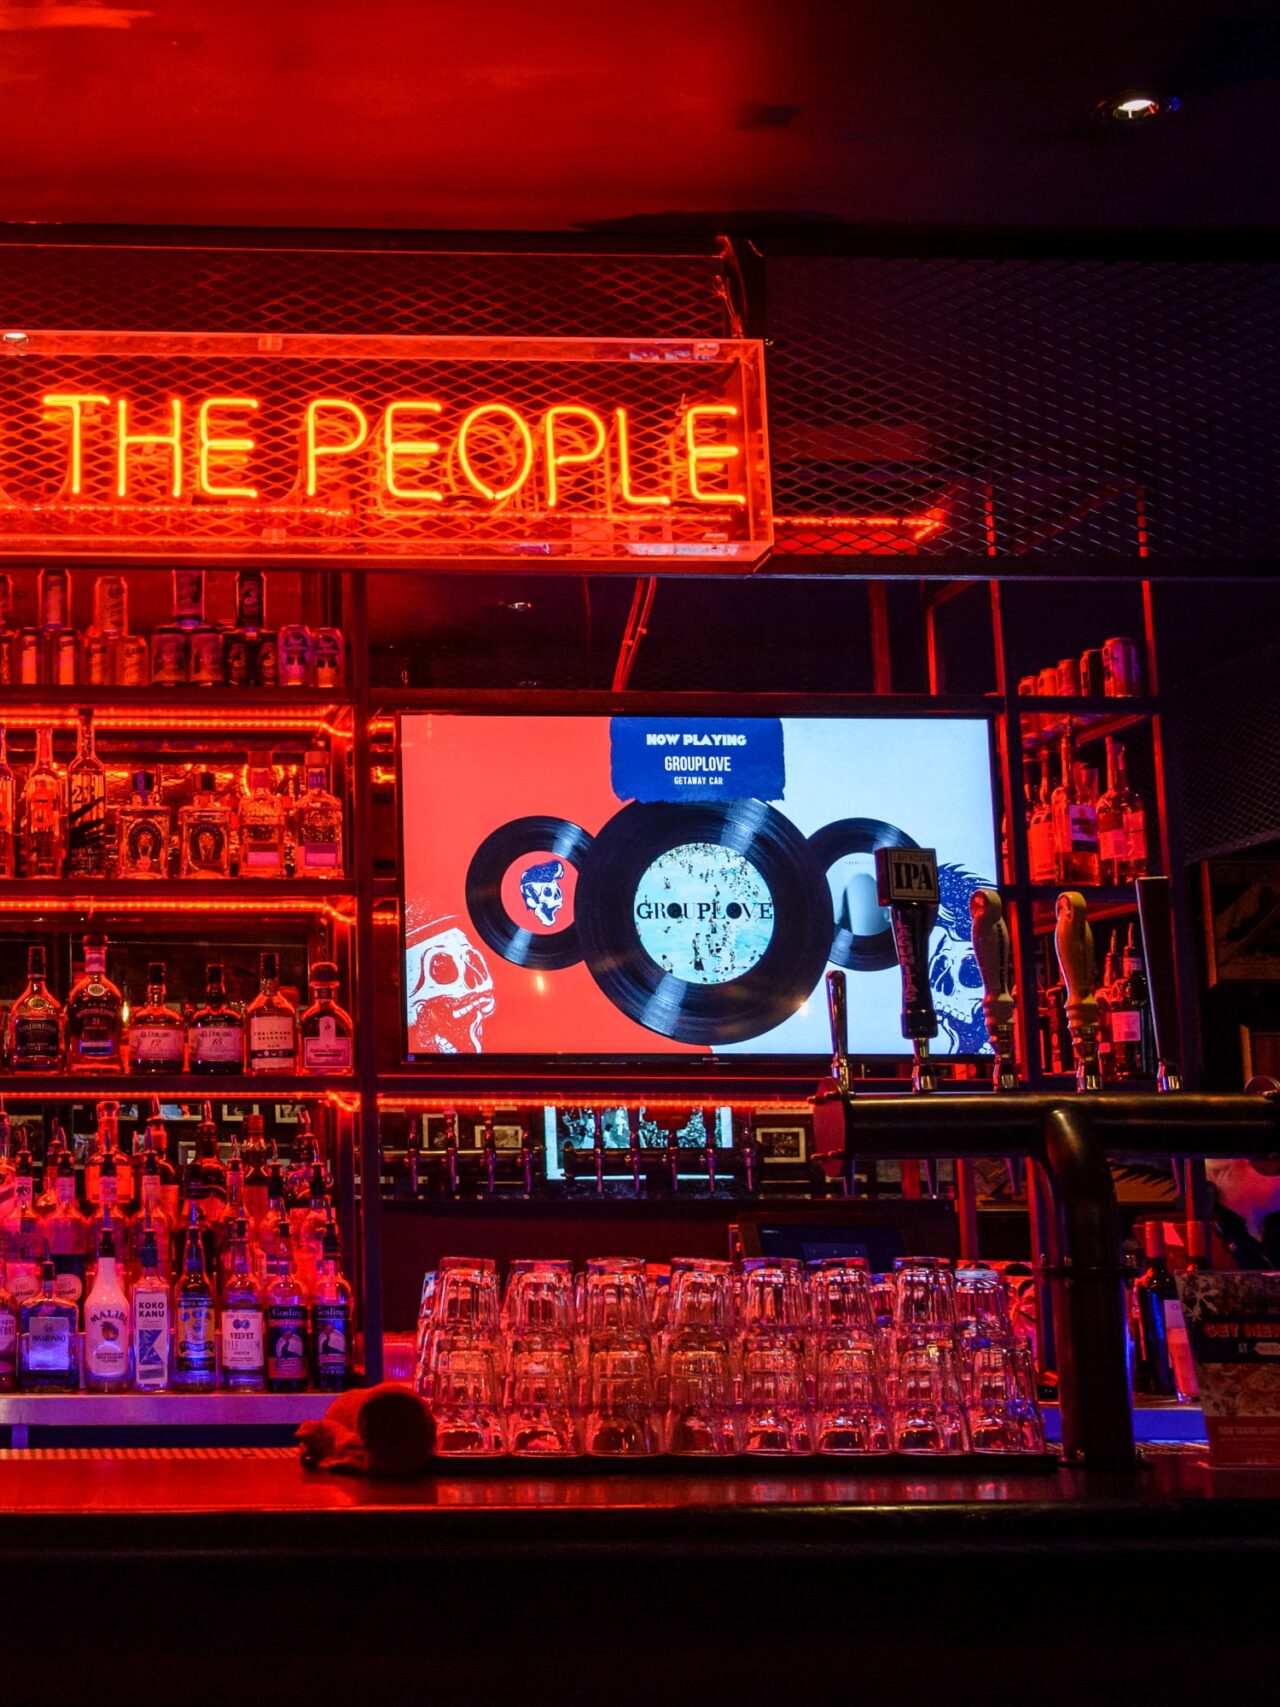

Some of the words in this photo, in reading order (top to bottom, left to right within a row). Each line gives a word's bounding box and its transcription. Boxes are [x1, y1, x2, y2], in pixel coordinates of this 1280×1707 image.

[43, 394, 258, 497] THE
[306, 399, 745, 505] PEOPLE
[646, 734, 680, 746] NOW
[683, 734, 747, 746] PLAYING
[664, 756, 732, 772] GROUPLOVE
[673, 776, 707, 785] GETAWAY
[709, 776, 723, 785] CAR
[892, 862, 934, 890] IPA
[636, 902, 774, 920] GROUPLOVE
[90, 1310, 128, 1325] MALIBU
[138, 1310, 165, 1318] KANU
[230, 1332, 254, 1340] VELVET
[1204, 1323, 1239, 1338] GET
